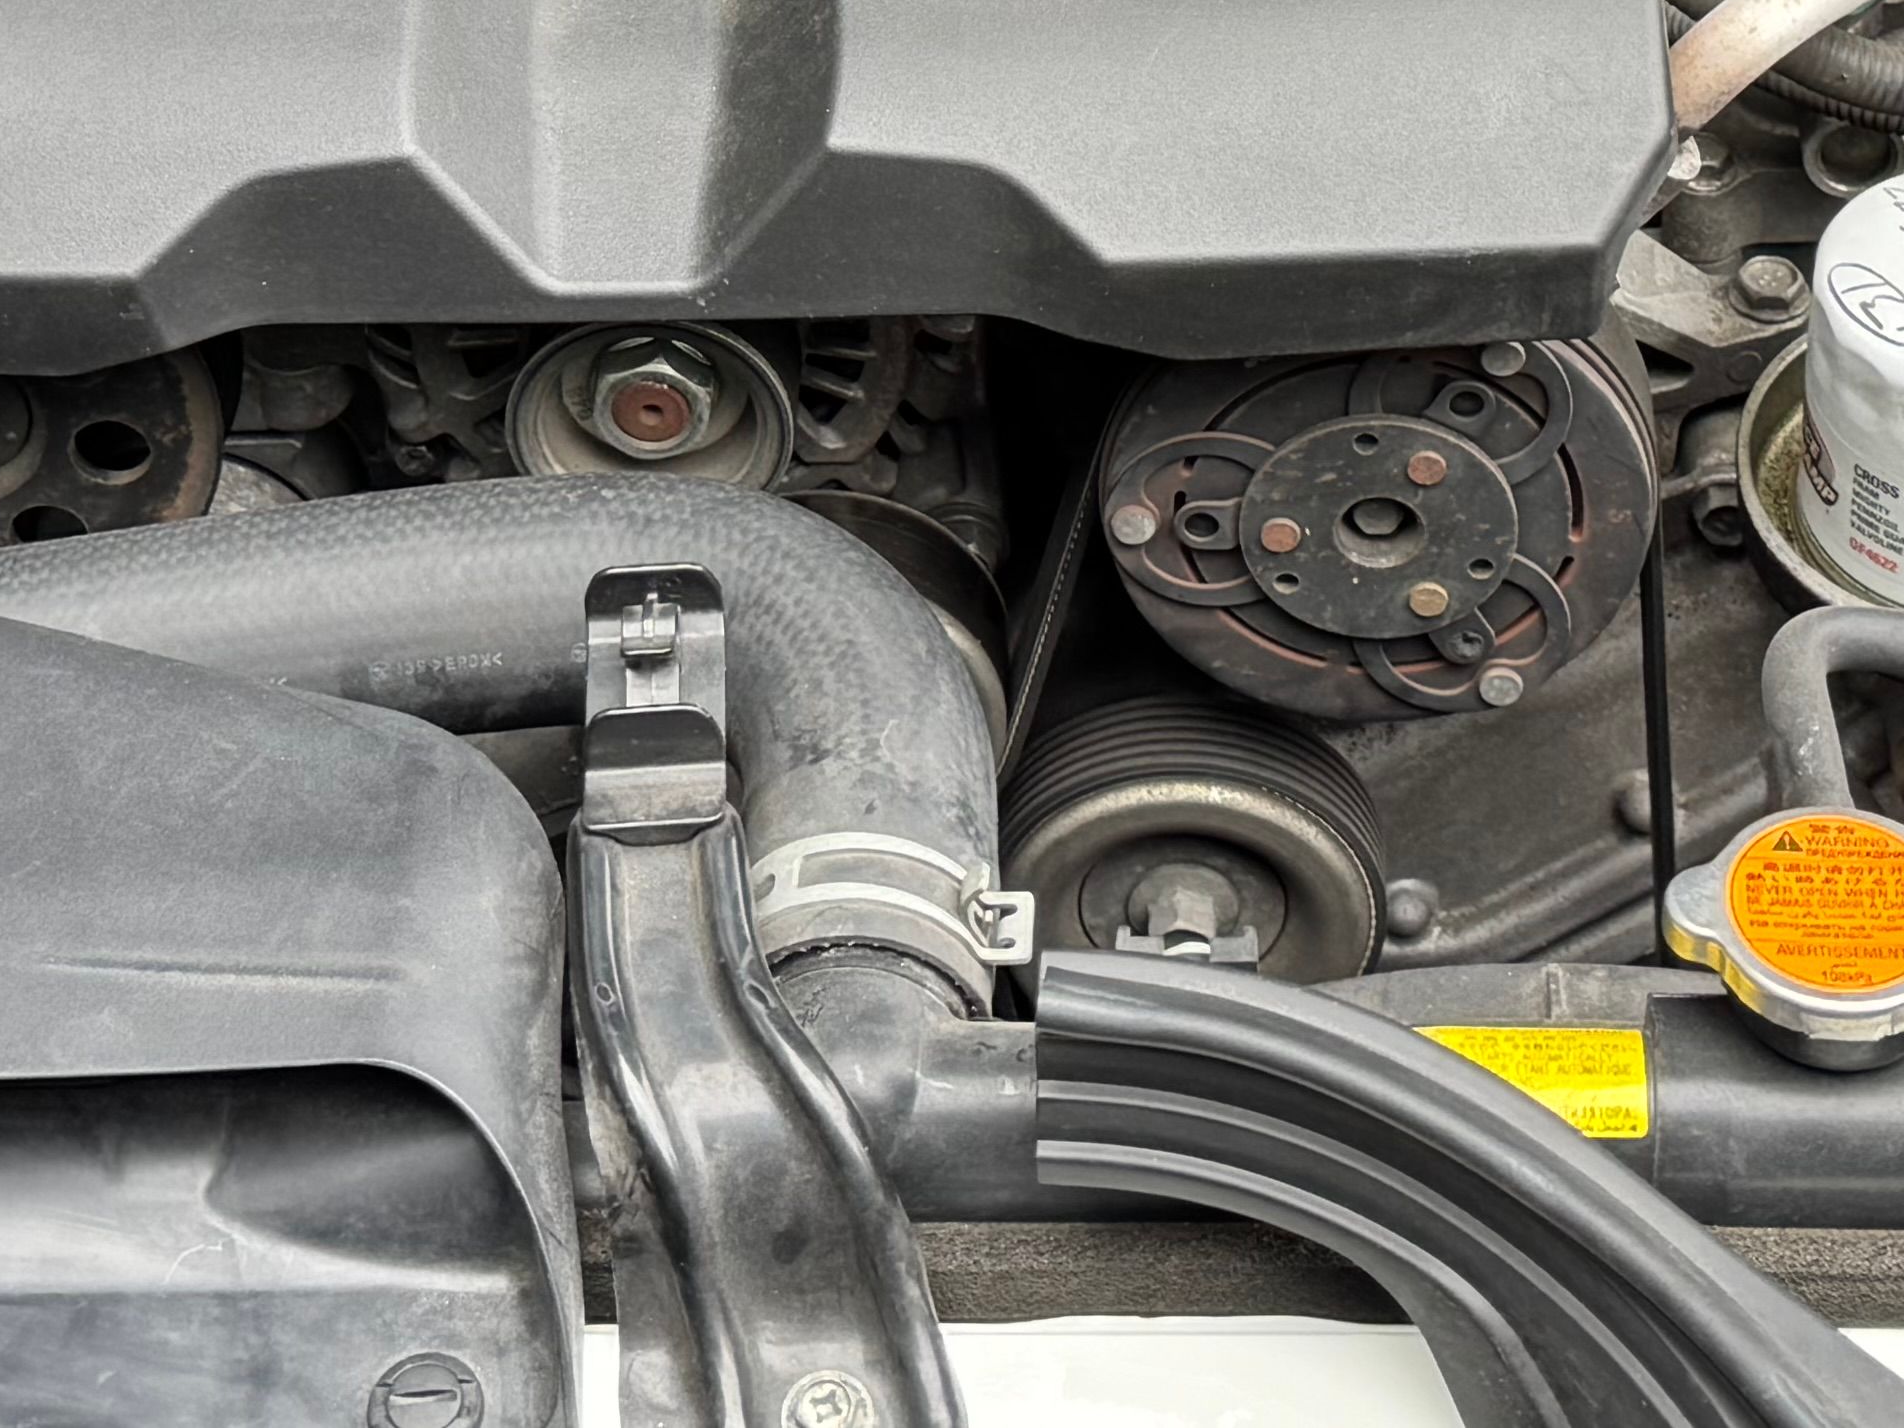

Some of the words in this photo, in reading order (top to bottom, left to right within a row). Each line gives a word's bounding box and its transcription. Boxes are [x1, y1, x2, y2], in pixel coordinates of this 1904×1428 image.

[1853, 463, 1900, 499] CROSS
[1851, 499, 1900, 533] PENNZOIL
[1852, 489, 1890, 515] MIGHTY
[1850, 509, 1881, 539] PRIME
[1850, 521, 1904, 556] VALVOLINE
[1805, 836, 1890, 848] WARNING
[1746, 884, 1793, 896] NEVER
[1799, 886, 1839, 897] OPEN
[1844, 887, 1888, 899] WHEN
[1822, 970, 1873, 985] 108kPa
